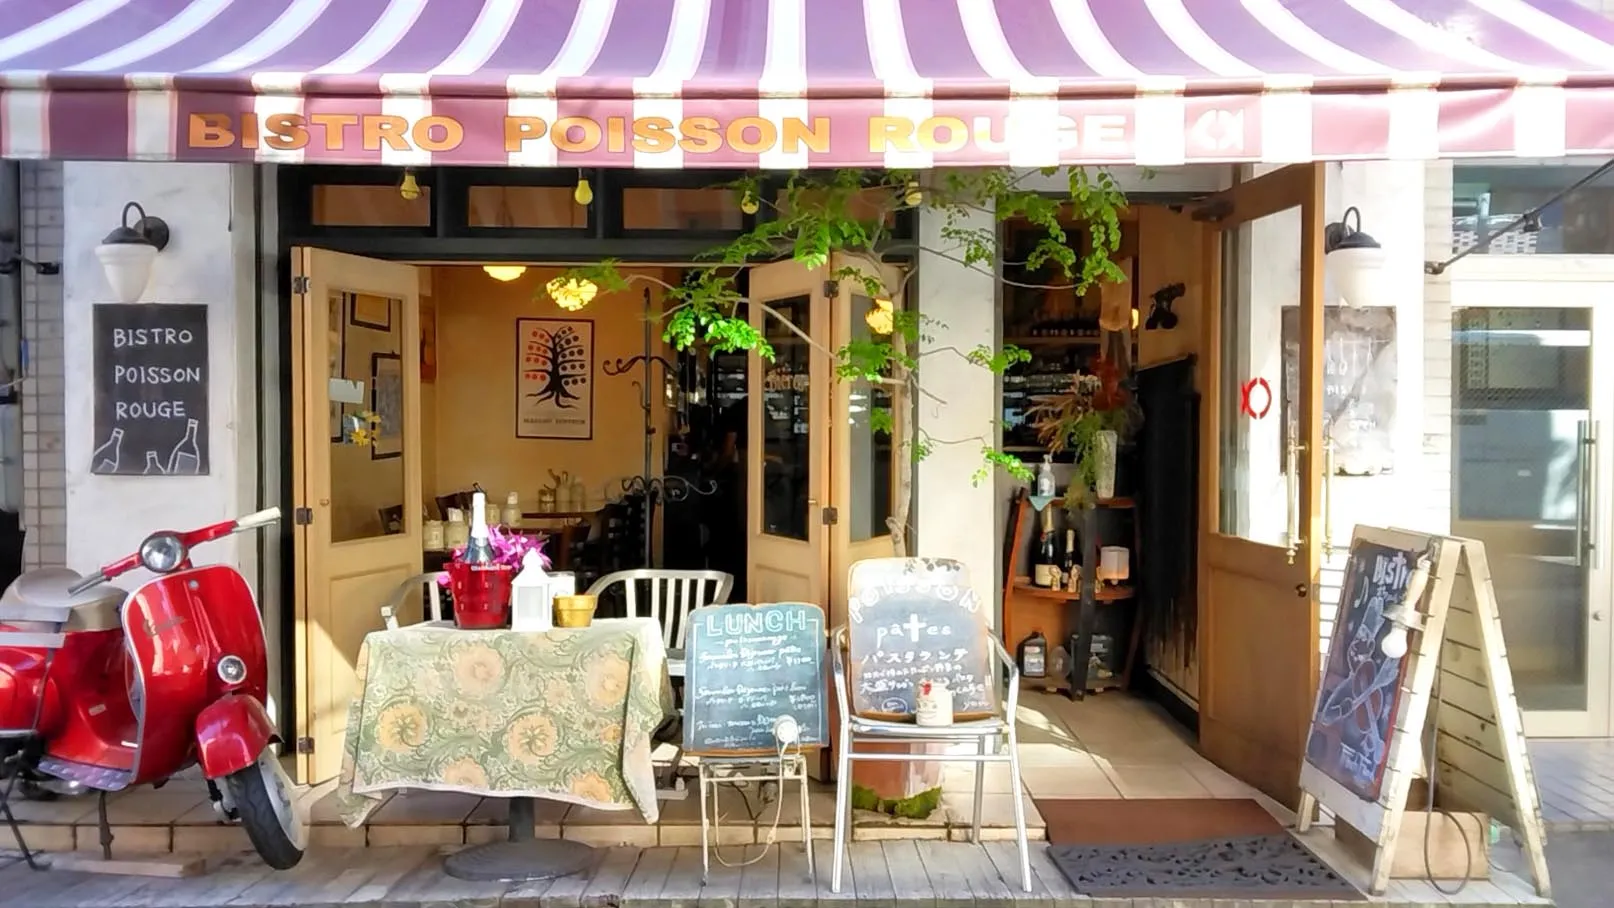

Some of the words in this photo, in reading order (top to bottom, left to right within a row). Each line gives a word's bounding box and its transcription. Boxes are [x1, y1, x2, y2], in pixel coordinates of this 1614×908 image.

[188, 113, 465, 152] BISTRO
[505, 115, 831, 155] POISSON
[113, 328, 193, 348] BISTRO
[114, 365, 200, 384] POISSON
[115, 401, 186, 420] ROUGE
[706, 610, 806, 637] LUNCH
